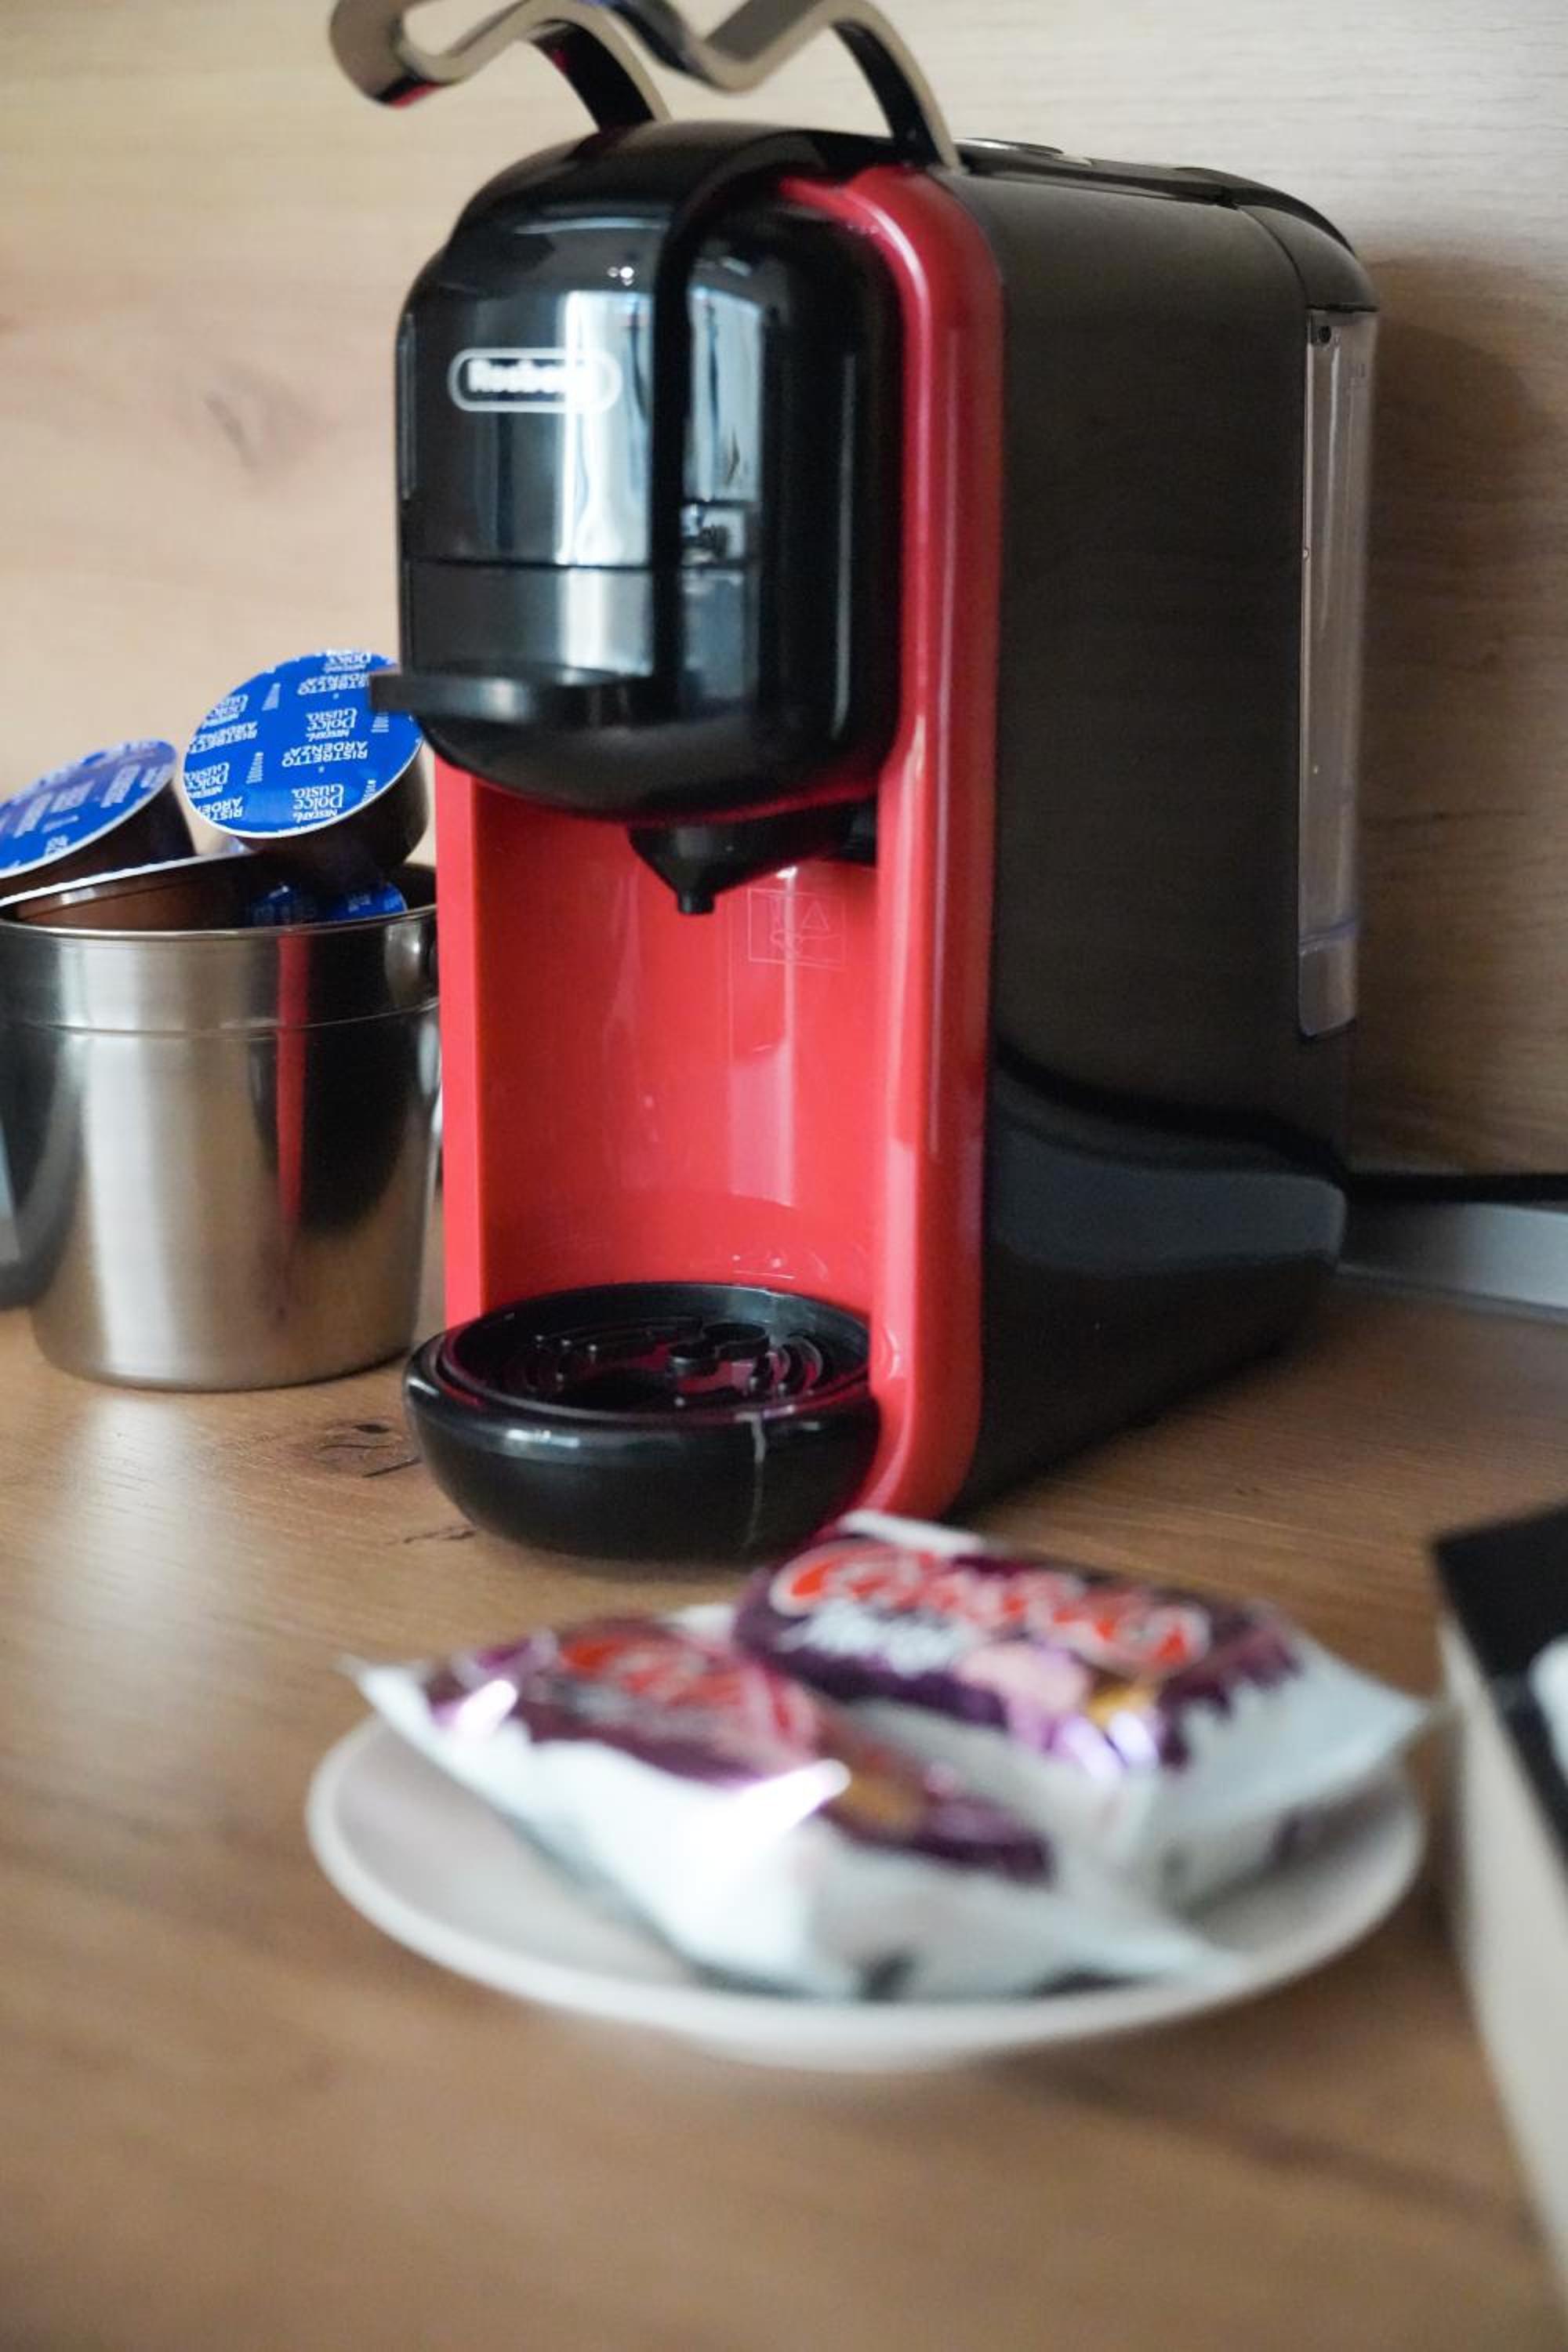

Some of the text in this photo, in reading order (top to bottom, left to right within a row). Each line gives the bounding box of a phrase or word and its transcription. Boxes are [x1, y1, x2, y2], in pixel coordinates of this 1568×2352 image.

[306, 708, 358, 721] Gusto
[307, 717, 355, 733] Dolce
[281, 749, 368, 768] RISTRETTO
[293, 784, 343, 798] Gusto
[293, 795, 343, 811] Dolce
